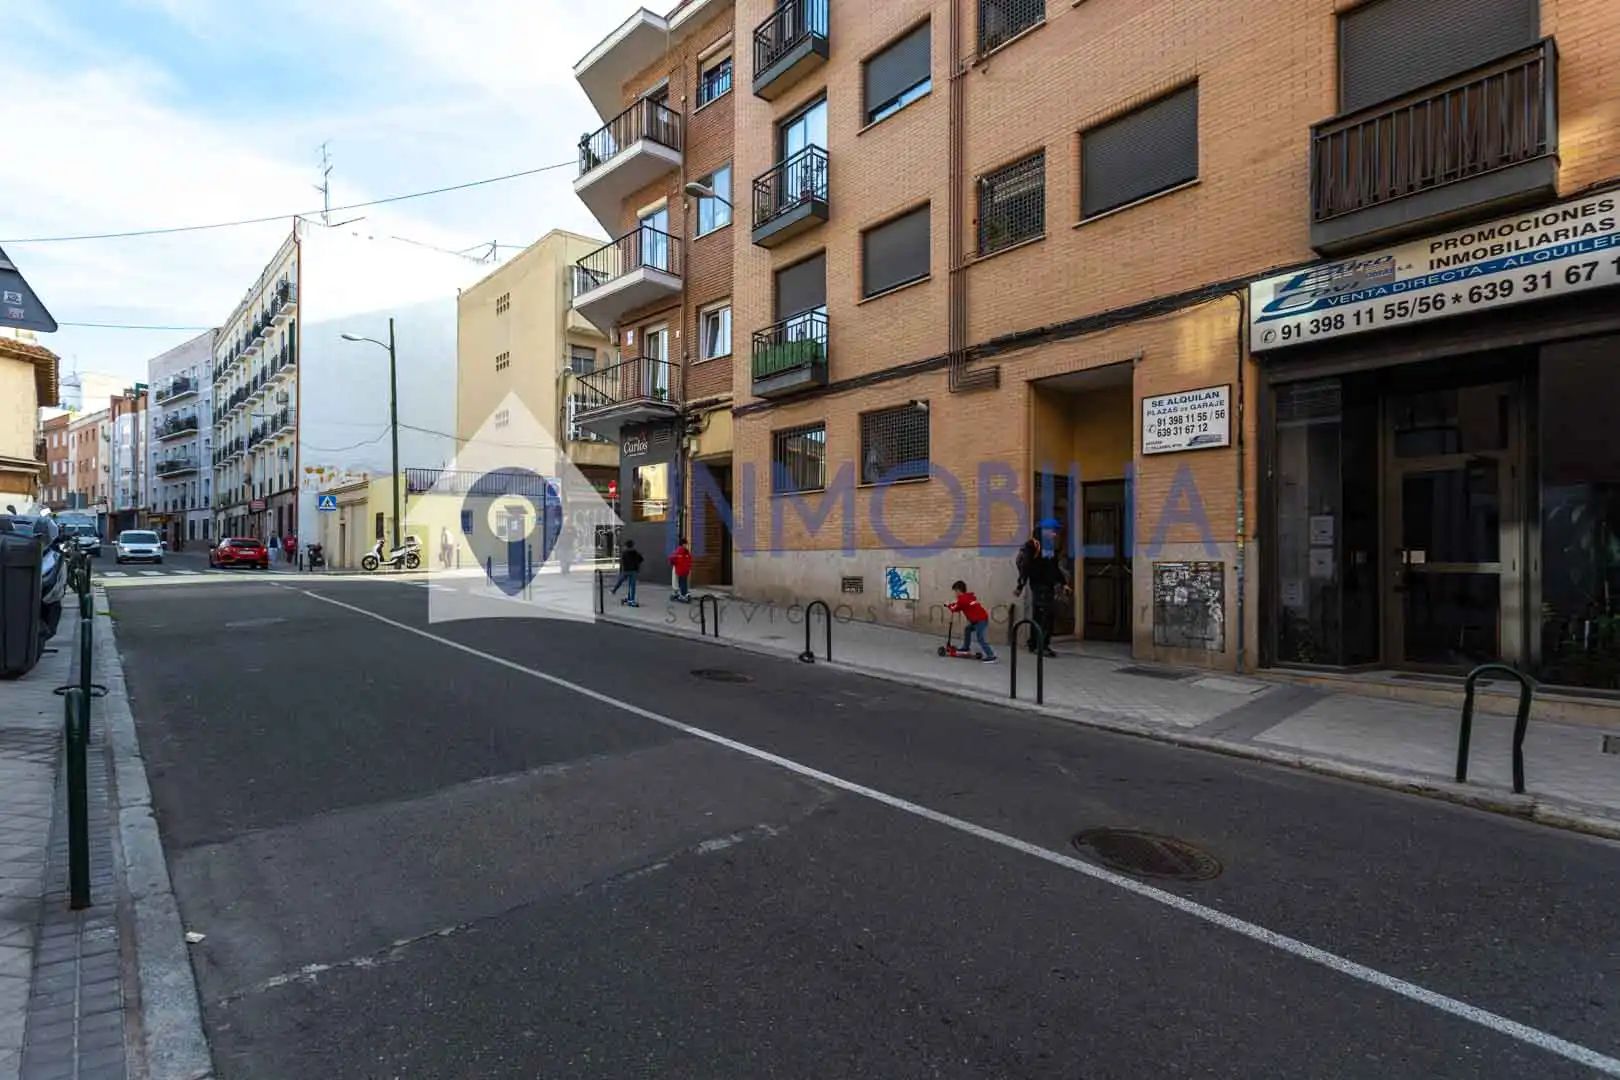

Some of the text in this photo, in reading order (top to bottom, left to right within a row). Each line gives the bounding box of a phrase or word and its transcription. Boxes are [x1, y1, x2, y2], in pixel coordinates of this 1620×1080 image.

[1429, 199, 1615, 254] PROMOCIONES
[1429, 217, 1616, 270] INMOBILIARIAS
[1327, 286, 1388, 305] VENTA
[1392, 266, 1483, 291] DIRECTA
[1281, 324, 1302, 340] 91
[1309, 314, 1345, 334] 398
[1353, 307, 1374, 326] 11
[1383, 292, 1446, 320] 55/56
[1468, 279, 1514, 303] 639
[1523, 270, 1551, 293] 31
[1565, 261, 1599, 284] 67
[1167, 391, 1220, 405] ALQUILAN
[1146, 407, 1178, 416] PLAZAS
[1190, 399, 1225, 410] GARAJE
[1157, 417, 1166, 427] 91
[1168, 415, 1183, 425] 398
[1186, 413, 1195, 422] 11
[1197, 412, 1207, 421] 55
[1214, 410, 1225, 420] 56
[1157, 423, 1208, 437] 639 31 67 12
[623, 439, 648, 455] Carlos
